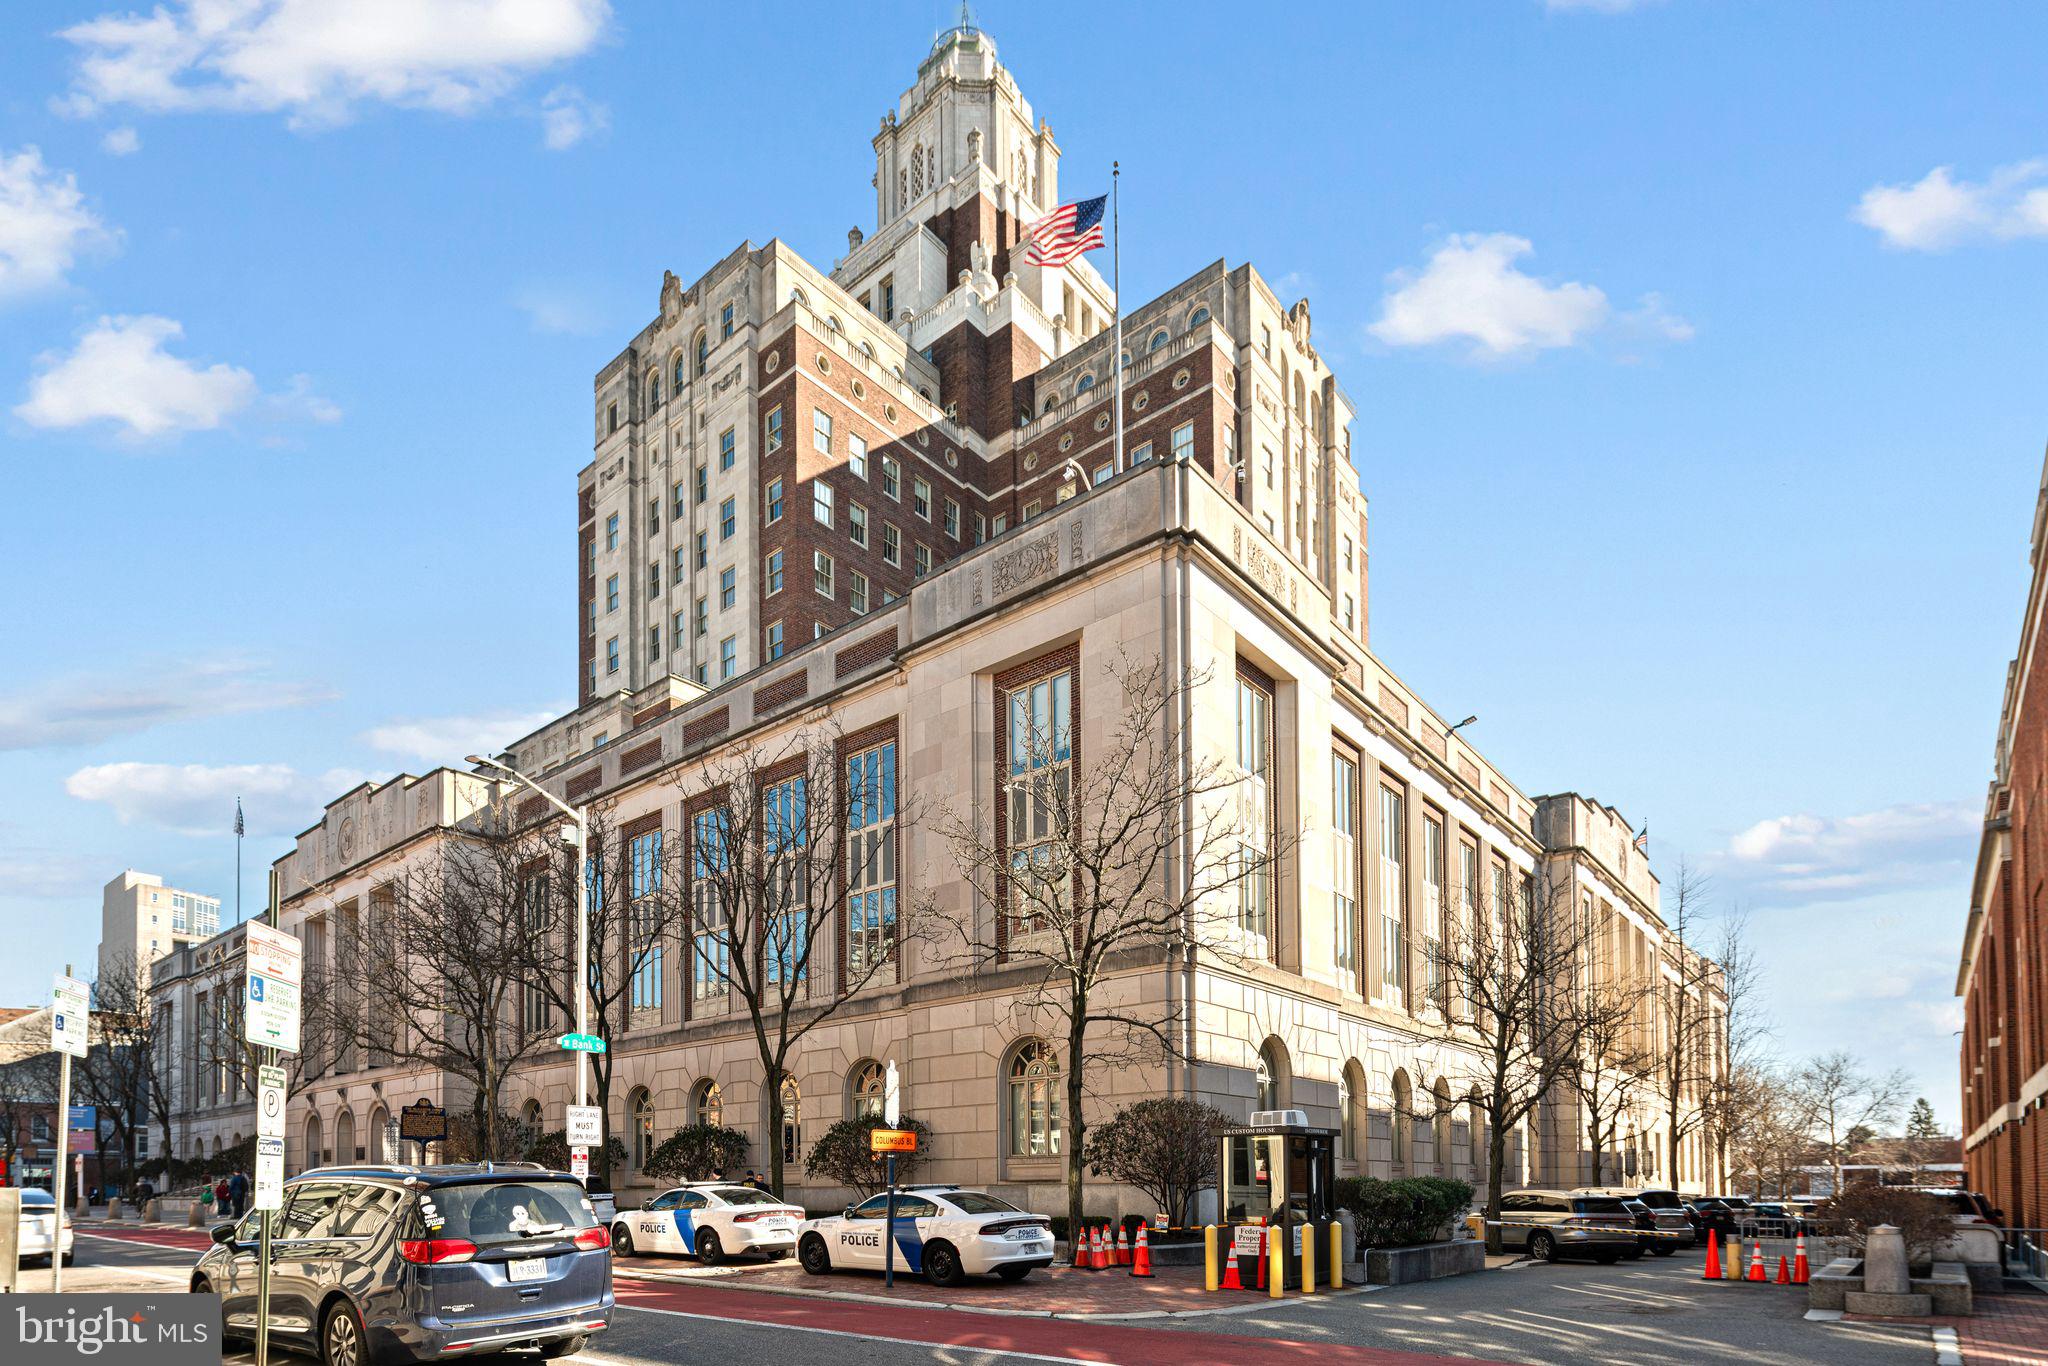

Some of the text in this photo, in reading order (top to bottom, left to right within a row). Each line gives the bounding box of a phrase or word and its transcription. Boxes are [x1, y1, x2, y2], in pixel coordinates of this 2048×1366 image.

[572, 1039, 593, 1050] Bank
[596, 1042, 605, 1052] St
[570, 1110, 599, 1119] RIGHT LANE
[575, 1121, 594, 1130] MUST
[585, 1133, 600, 1141] RIGHT
[875, 1136, 905, 1145] COLUMBUS
[640, 1224, 666, 1234] POLICE
[1240, 1227, 1261, 1235] Feder
[841, 1234, 879, 1247] POLICE
[1238, 1234, 1261, 1242] Proper
